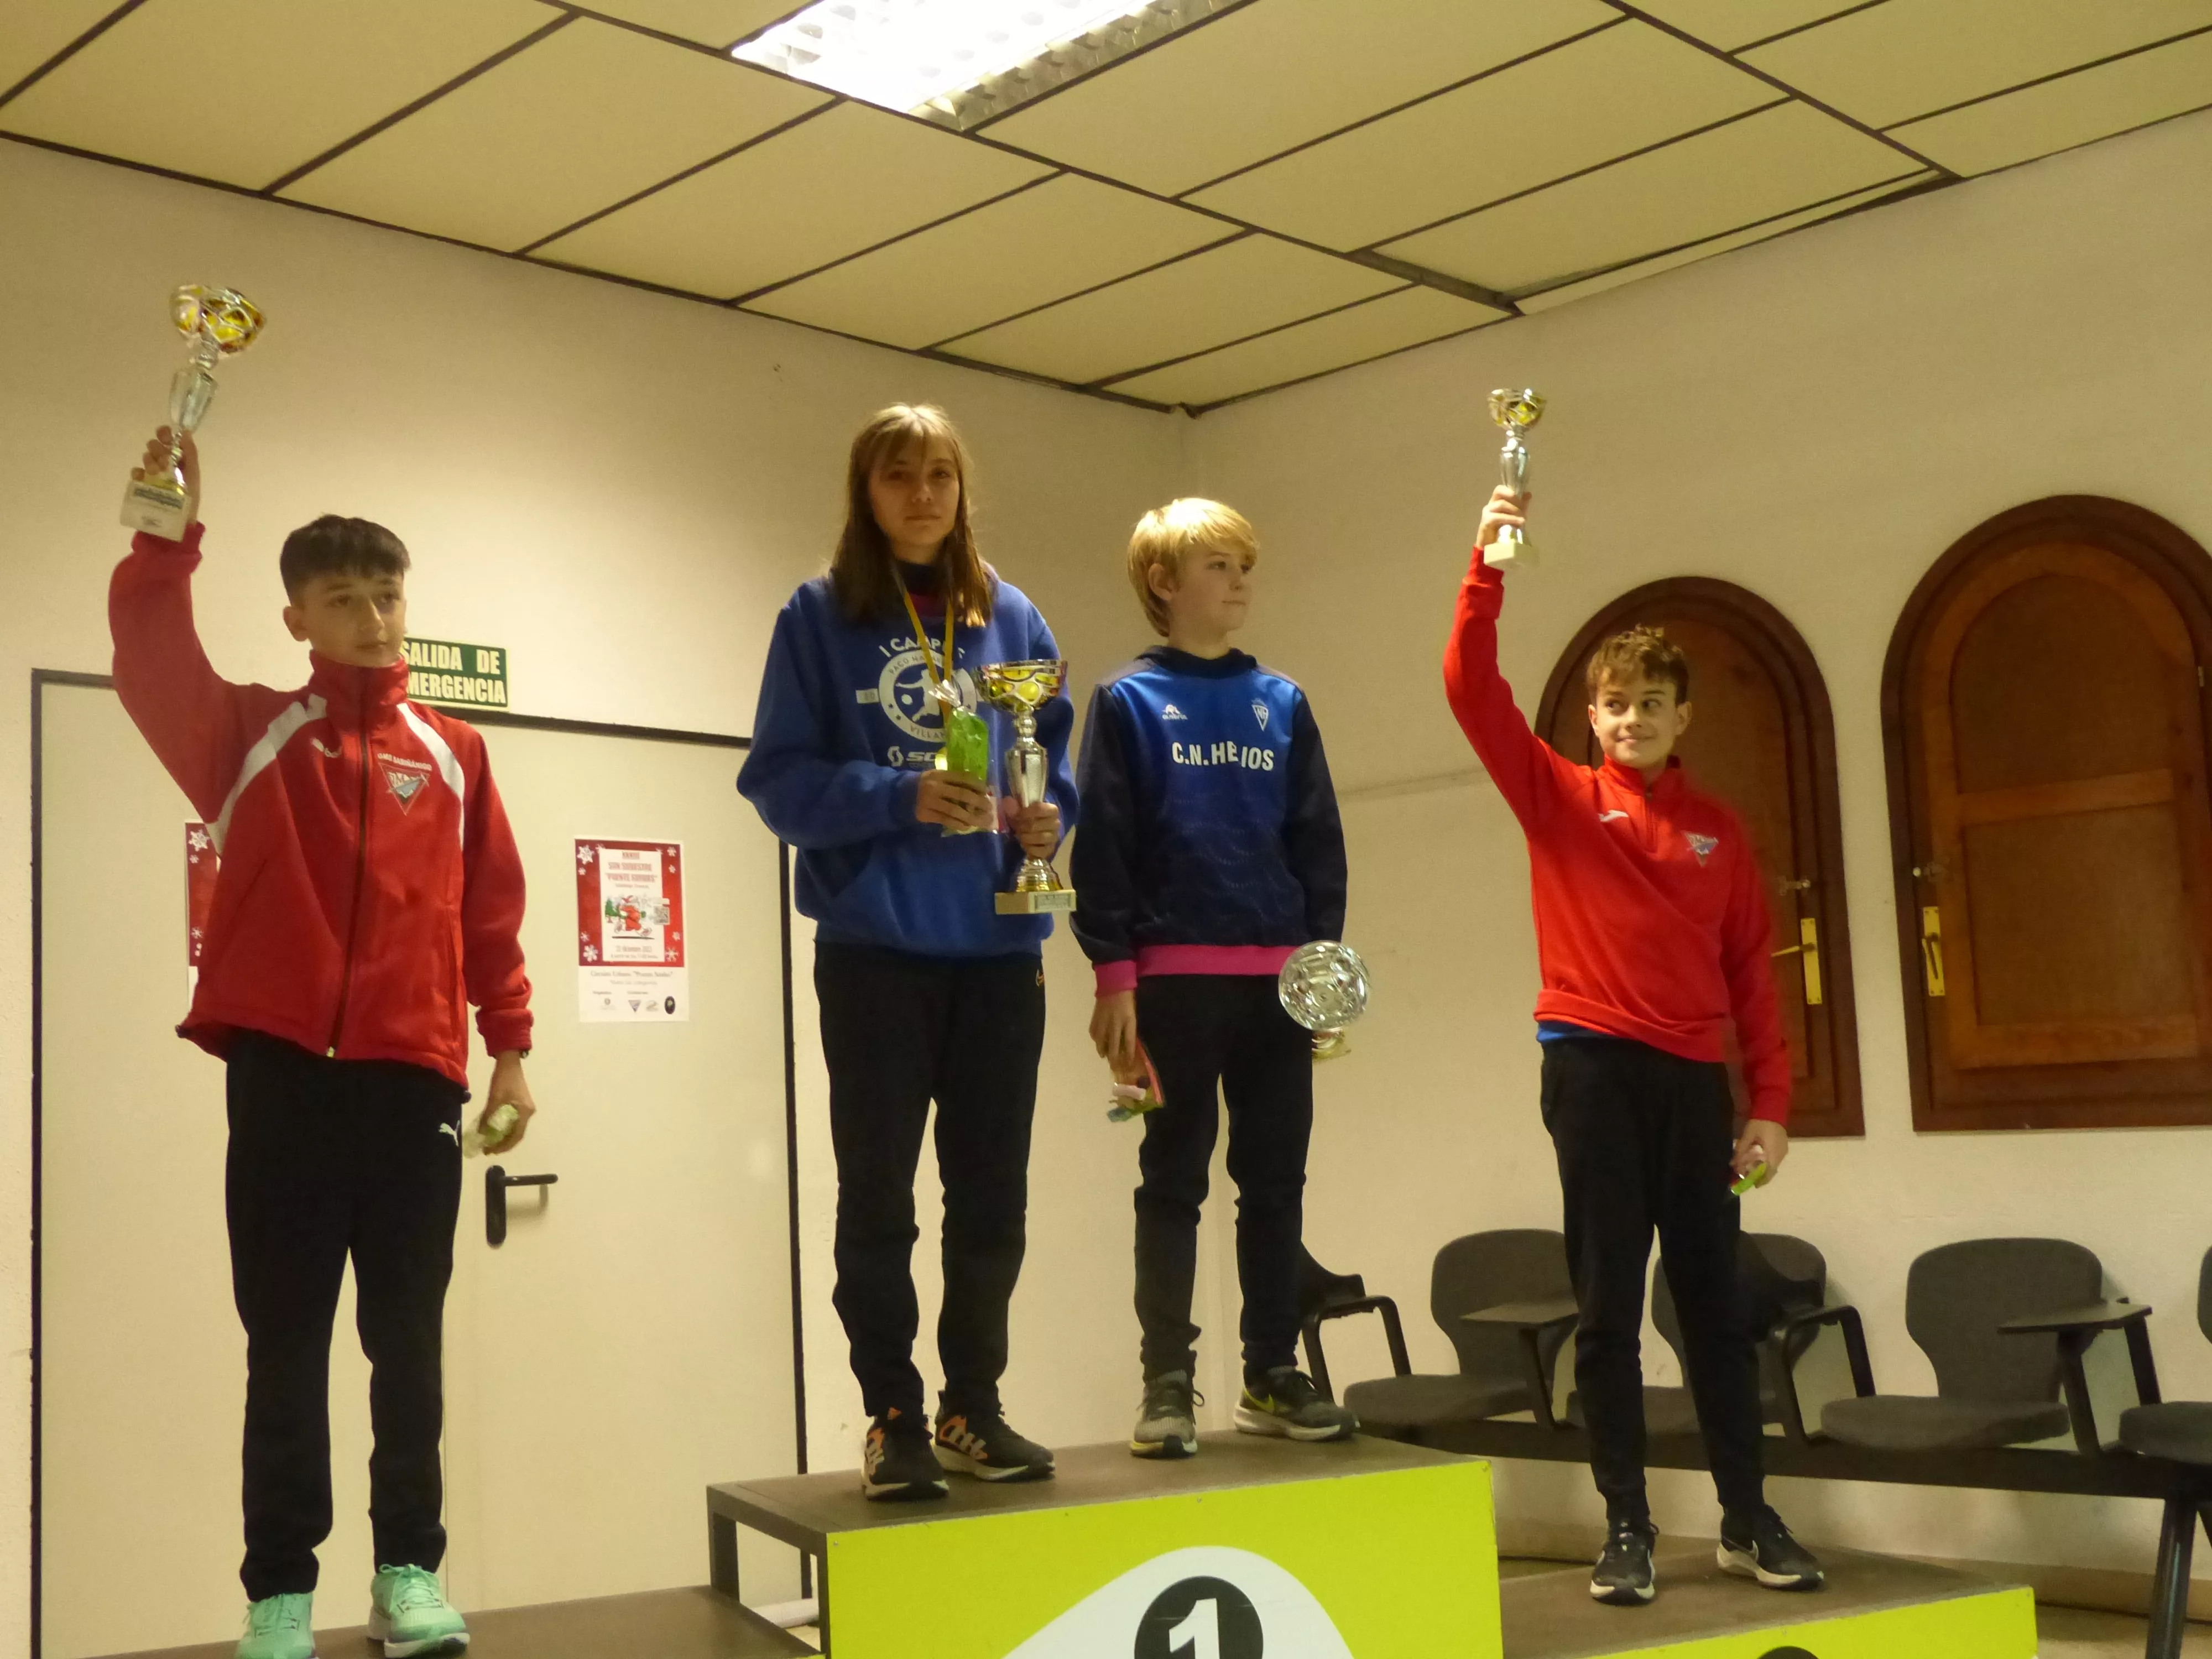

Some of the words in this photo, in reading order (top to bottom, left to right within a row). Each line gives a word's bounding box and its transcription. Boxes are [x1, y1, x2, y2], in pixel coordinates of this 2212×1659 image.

[399, 640, 463, 671] SALIDA
[476, 649, 500, 675] DE
[408, 671, 507, 704] MERGENCIA
[1172, 742, 1209, 766] C.N.
[1211, 740, 1275, 771] HEIOS
[1168, 1597, 1220, 1659] 1
